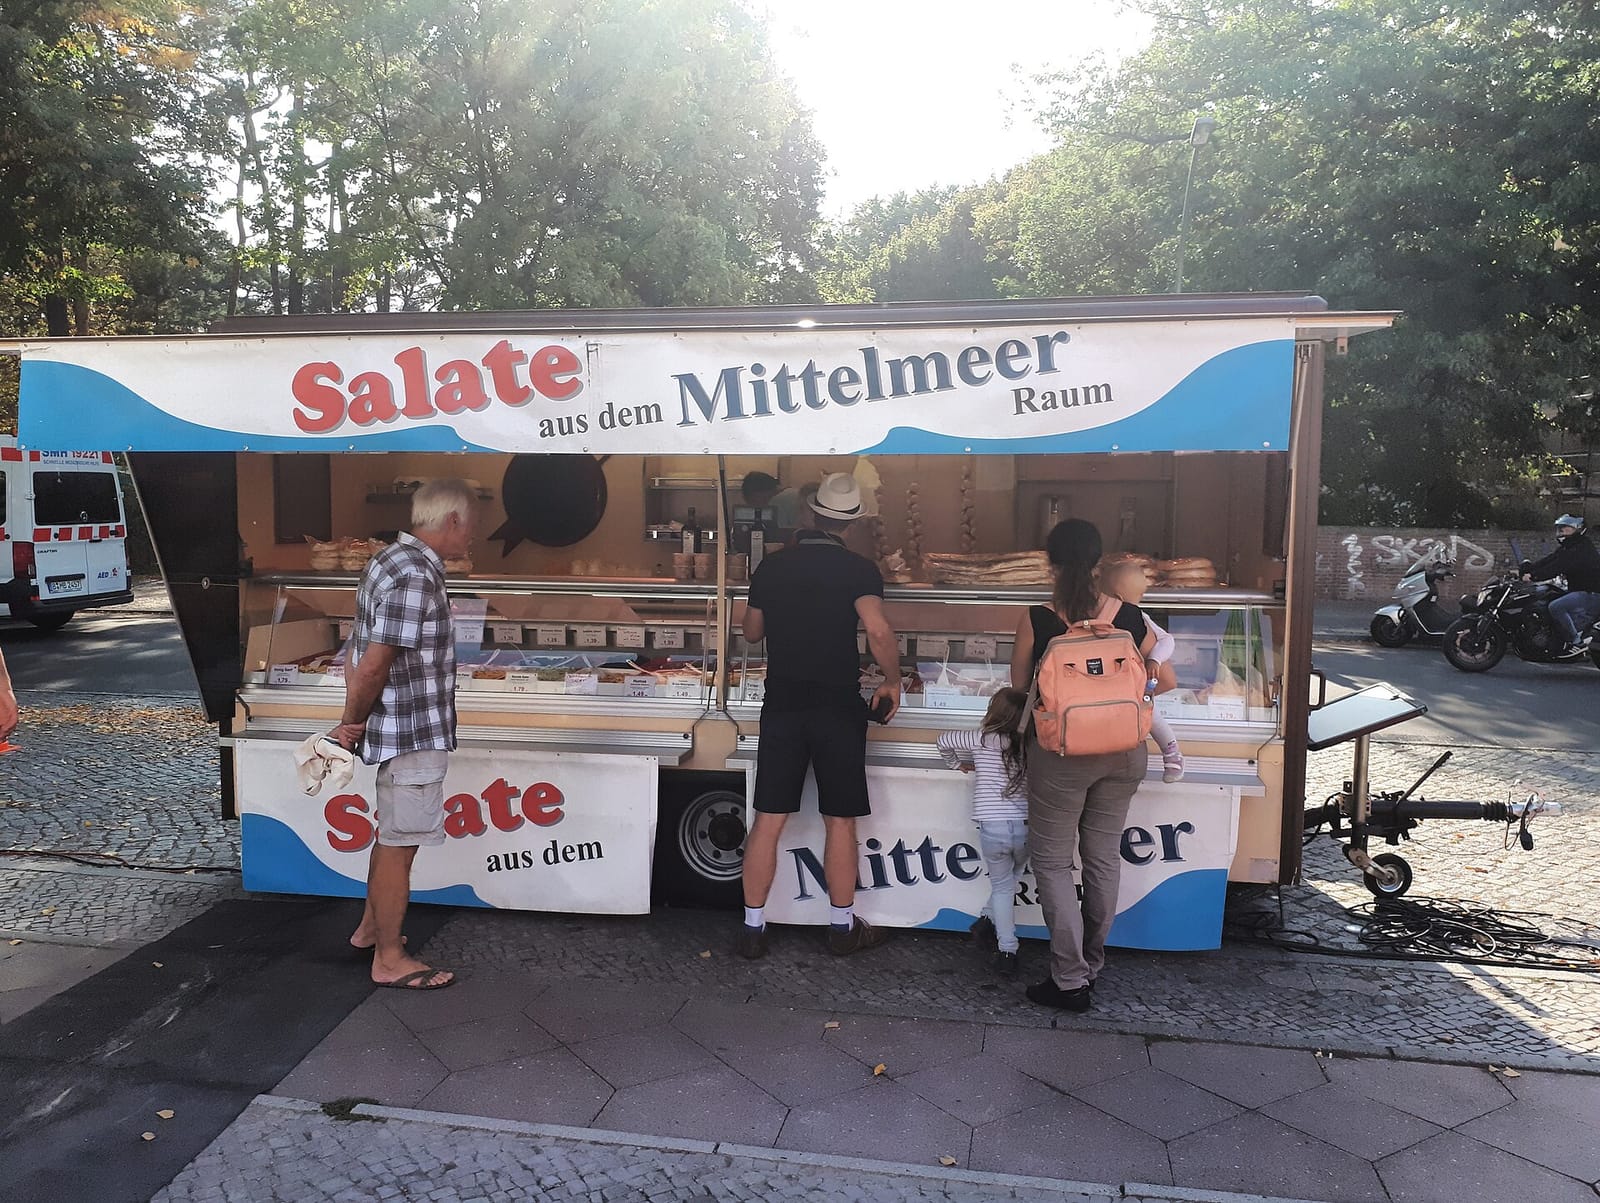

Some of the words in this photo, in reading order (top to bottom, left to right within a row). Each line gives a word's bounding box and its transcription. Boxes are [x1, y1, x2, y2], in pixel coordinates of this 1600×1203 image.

[292, 339, 584, 434] Salate
[671, 329, 1071, 427] Mittelmeer
[1012, 381, 1113, 415] Raum
[538, 410, 589, 439] aus
[599, 402, 663, 431] dem
[97, 571, 109, 579] AED
[324, 777, 564, 852] Sate
[486, 849, 533, 873] aus
[543, 840, 604, 866] dem
